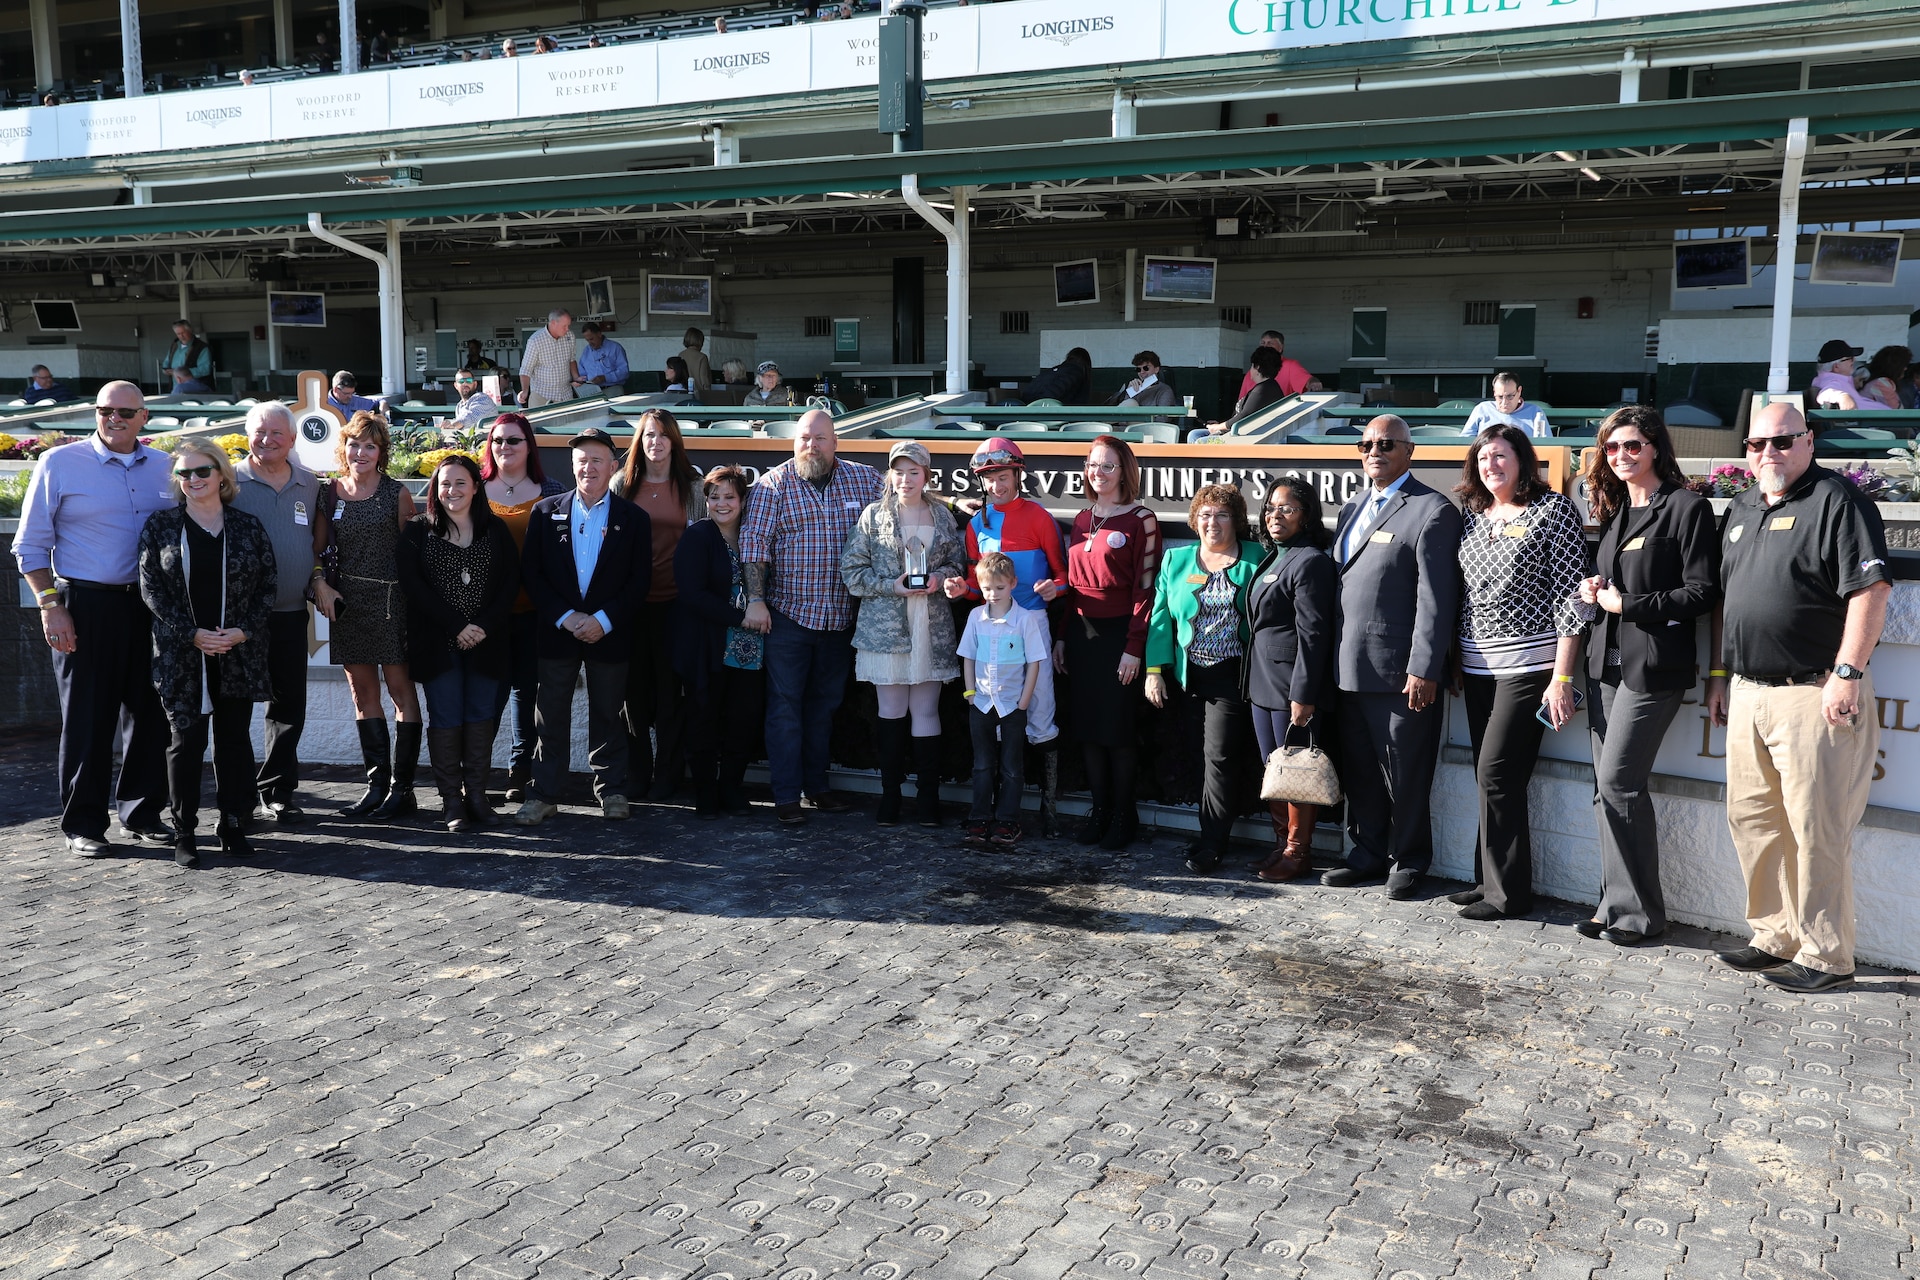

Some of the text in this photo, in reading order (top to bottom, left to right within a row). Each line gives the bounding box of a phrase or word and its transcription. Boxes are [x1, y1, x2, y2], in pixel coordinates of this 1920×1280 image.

[1021, 15, 1114, 39] LONGINES
[847, 31, 939, 50] WOORD
[693, 51, 770, 72] LONGINES
[548, 65, 624, 81] WOODFORD
[419, 81, 484, 99] LONGINES
[556, 81, 617, 97] RESERVE
[296, 92, 361, 107] WOODFORD
[80, 115, 137, 128] WOODFORD
[186, 106, 242, 122] LONGINES
[302, 107, 356, 121] RESERVE
[86, 129, 132, 141] RESERVE
[1138, 467, 1267, 500] INNER'S
